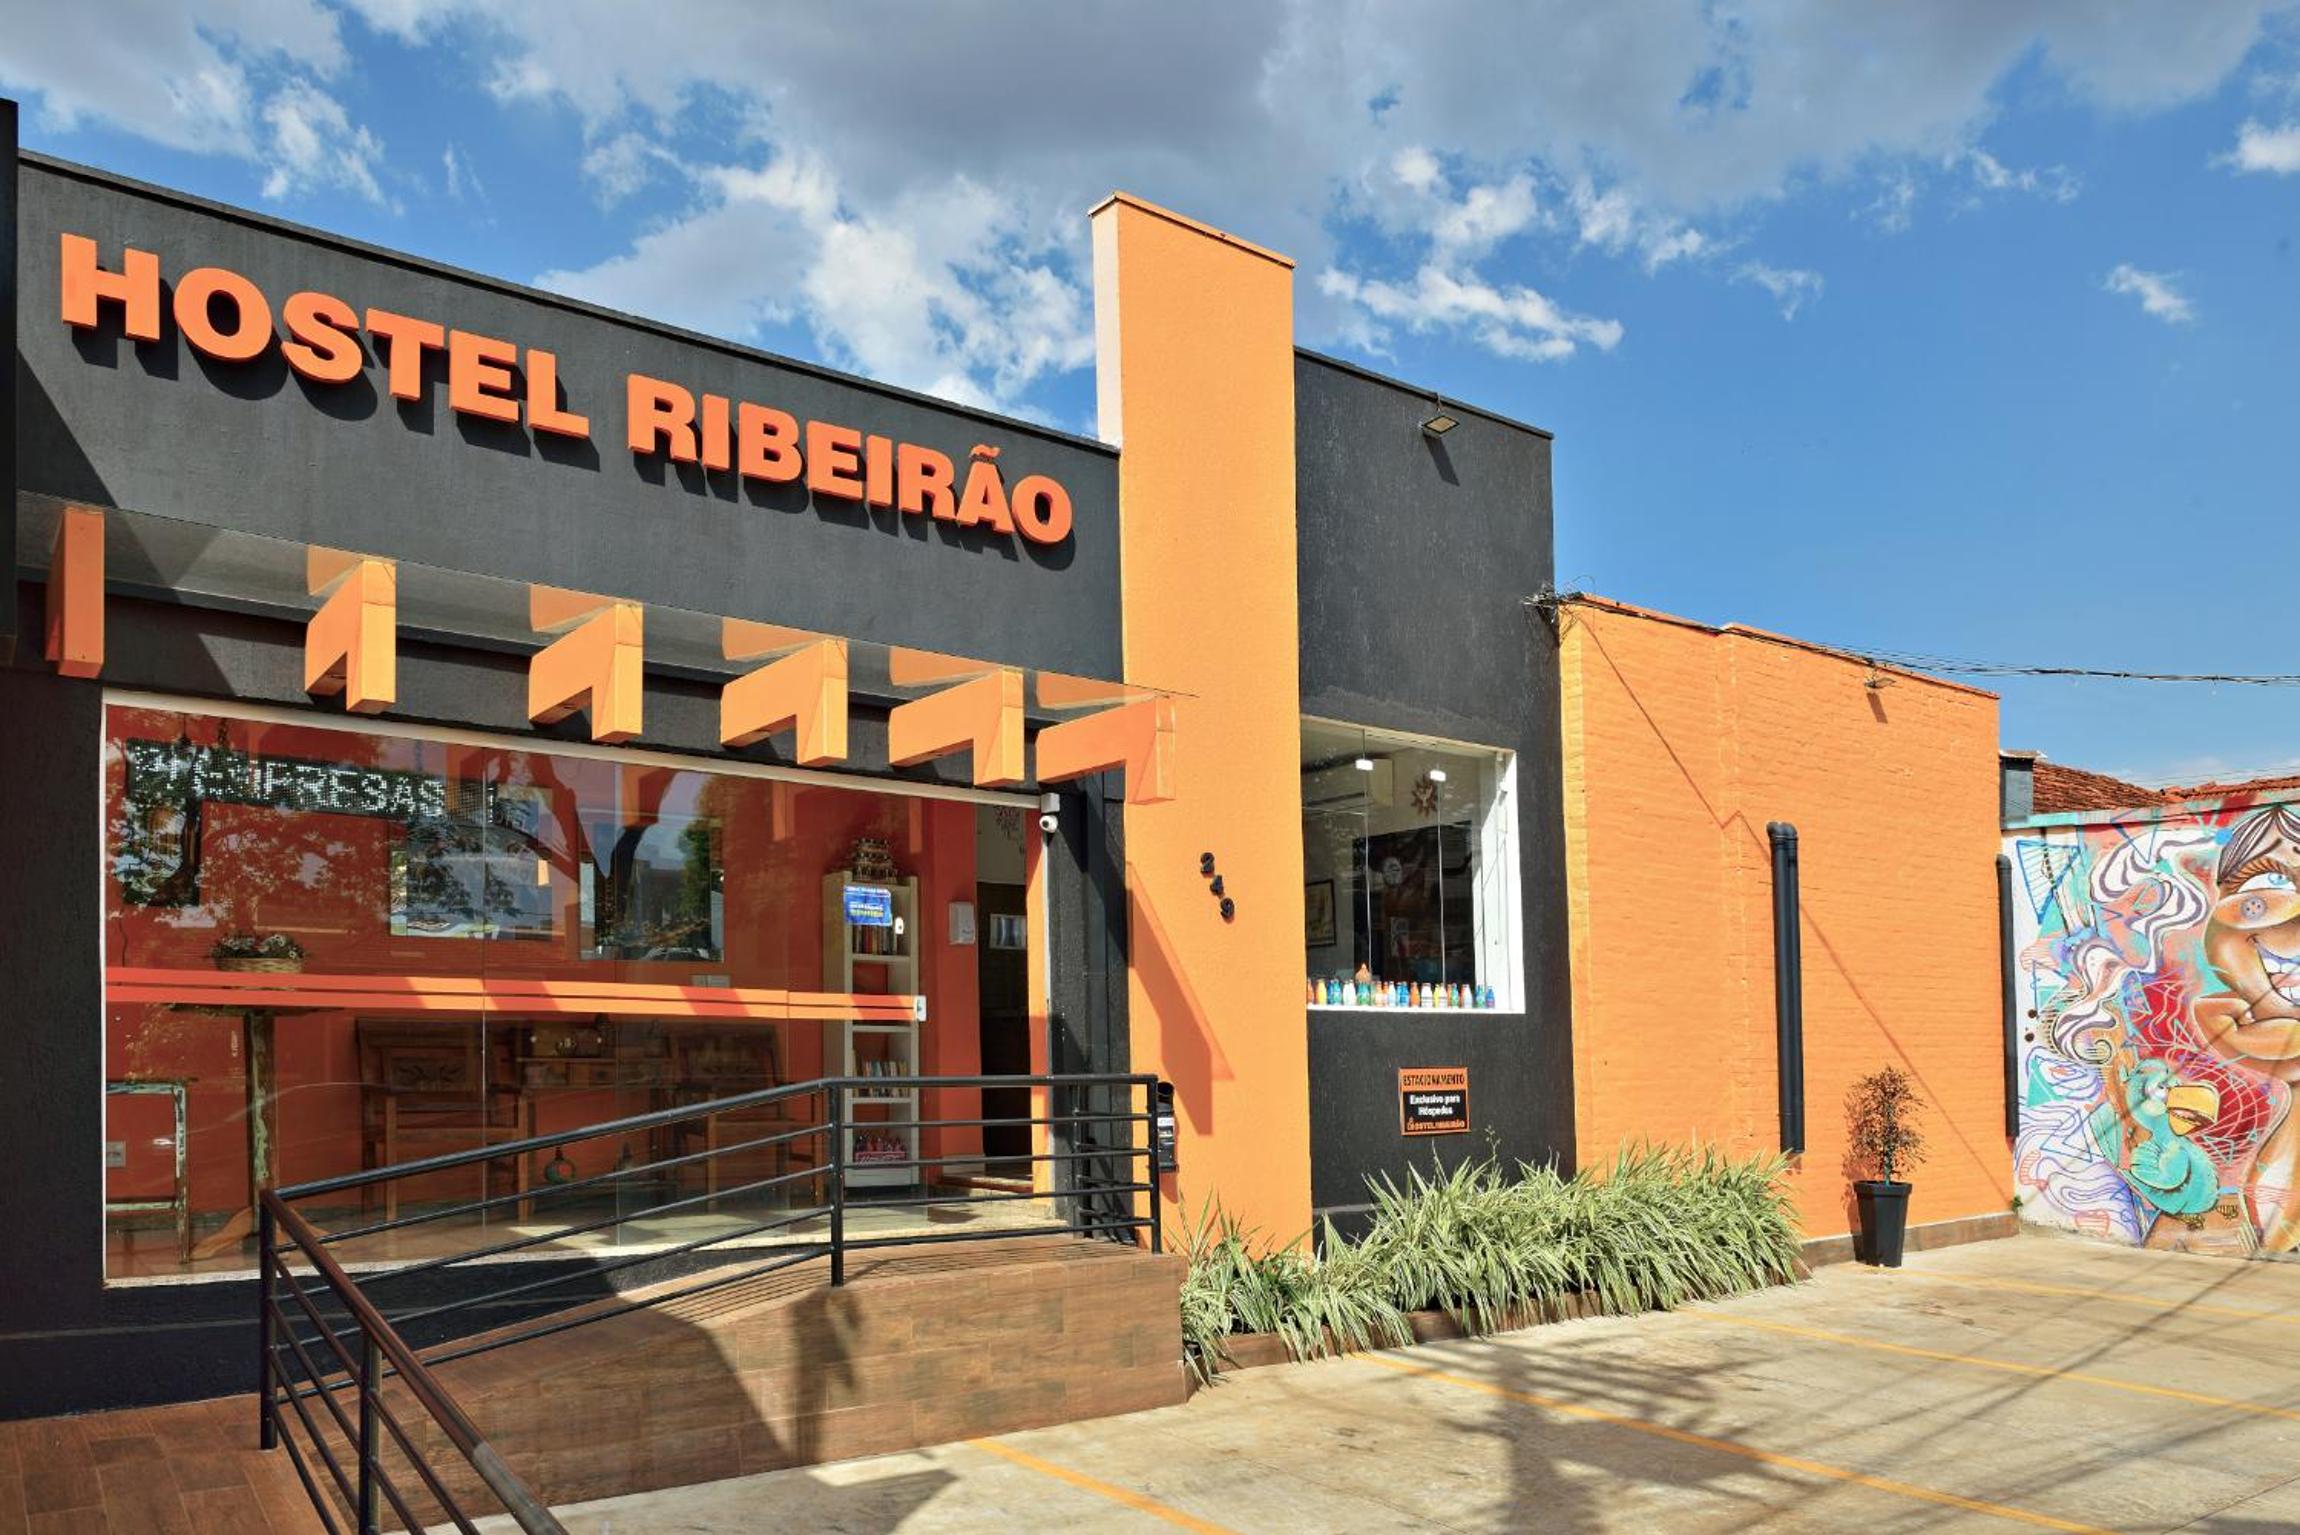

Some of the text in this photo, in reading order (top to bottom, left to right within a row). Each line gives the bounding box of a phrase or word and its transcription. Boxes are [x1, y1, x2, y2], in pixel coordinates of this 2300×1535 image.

[61, 233, 1074, 544] HOSTEL RIBEIRÃO
[1403, 1074, 1465, 1086] ESTACIONAMENTO
[1410, 1094, 1443, 1104] Exclusivo
